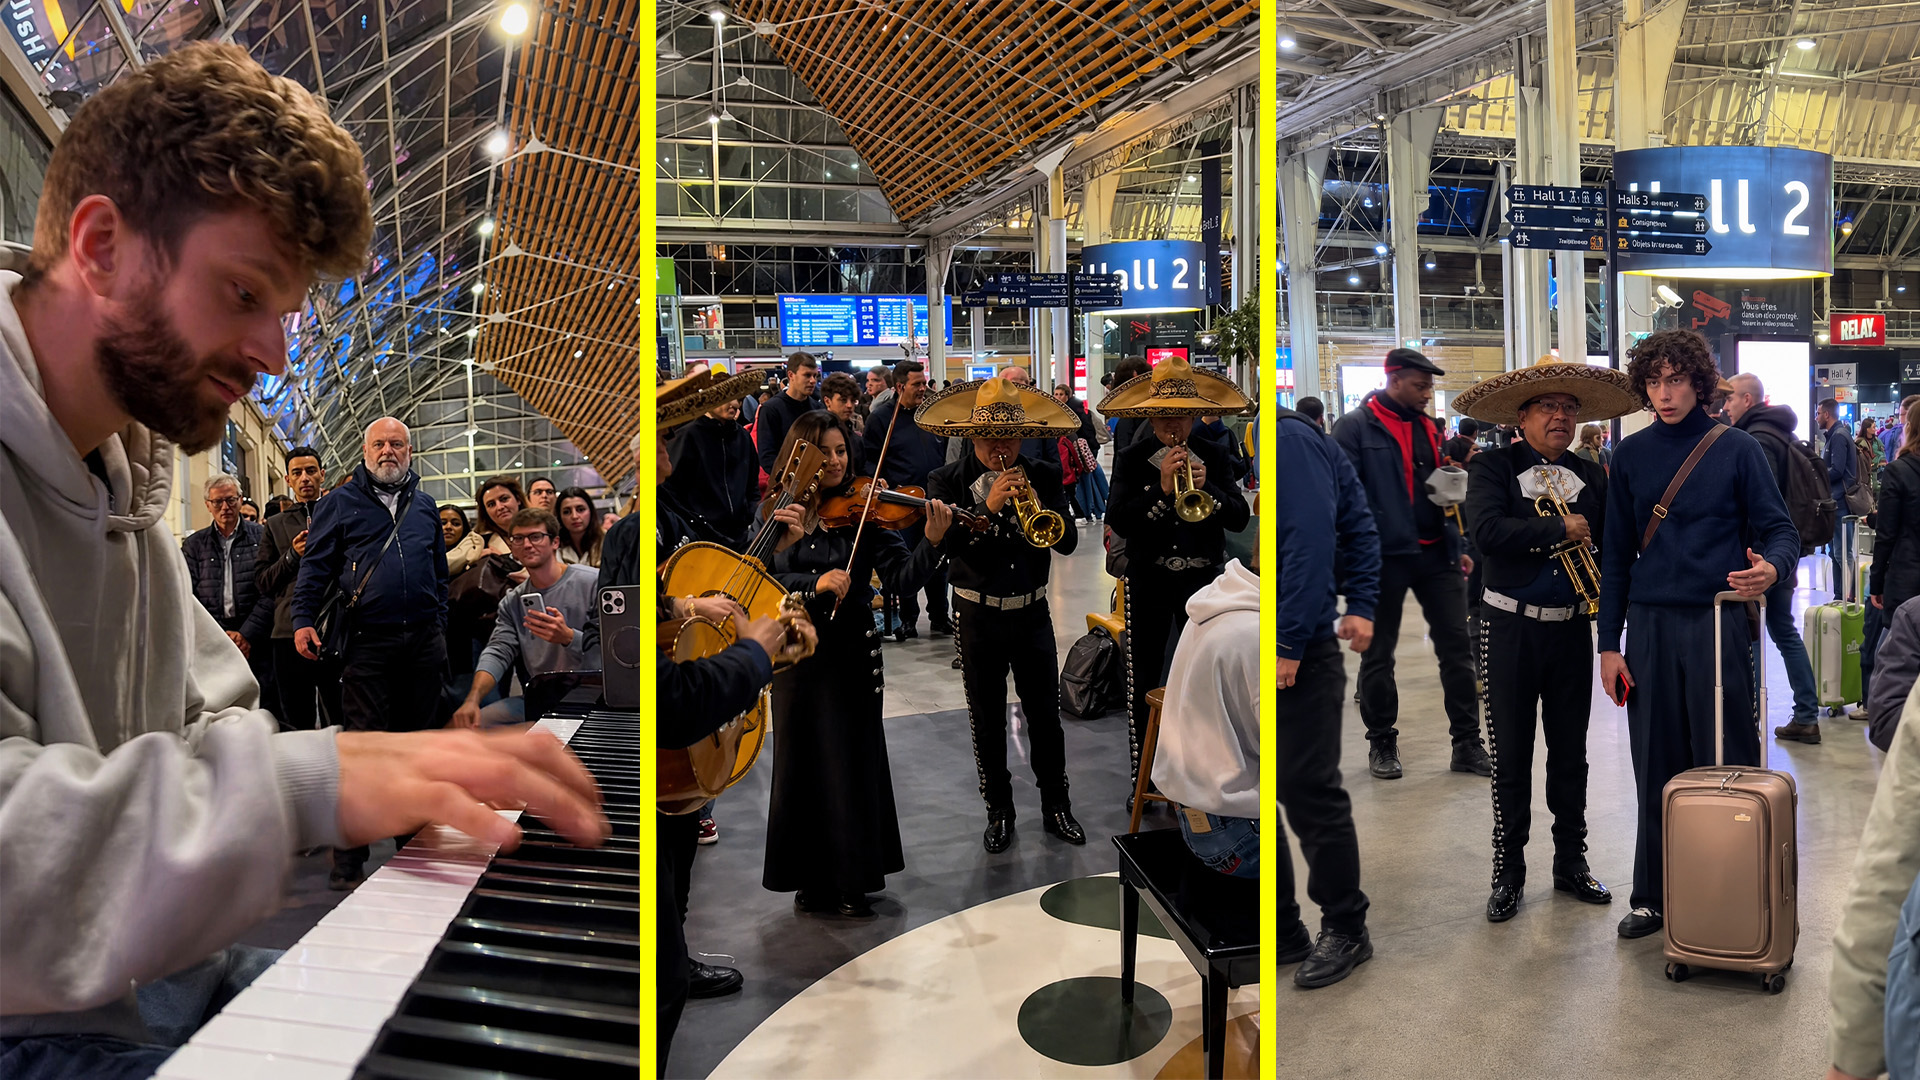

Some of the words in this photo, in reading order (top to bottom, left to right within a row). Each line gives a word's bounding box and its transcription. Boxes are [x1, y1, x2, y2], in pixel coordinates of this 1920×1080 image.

[1533, 190, 1555, 201] Hall
[1559, 191, 1565, 202] 1
[1618, 194, 1640, 205] Halls
[1642, 195, 1649, 206] 3
[1783, 180, 1810, 236] 2
[1172, 257, 1189, 289] 2
[1741, 301, 1759, 311] Vous
[1831, 369, 1844, 378] Hall
